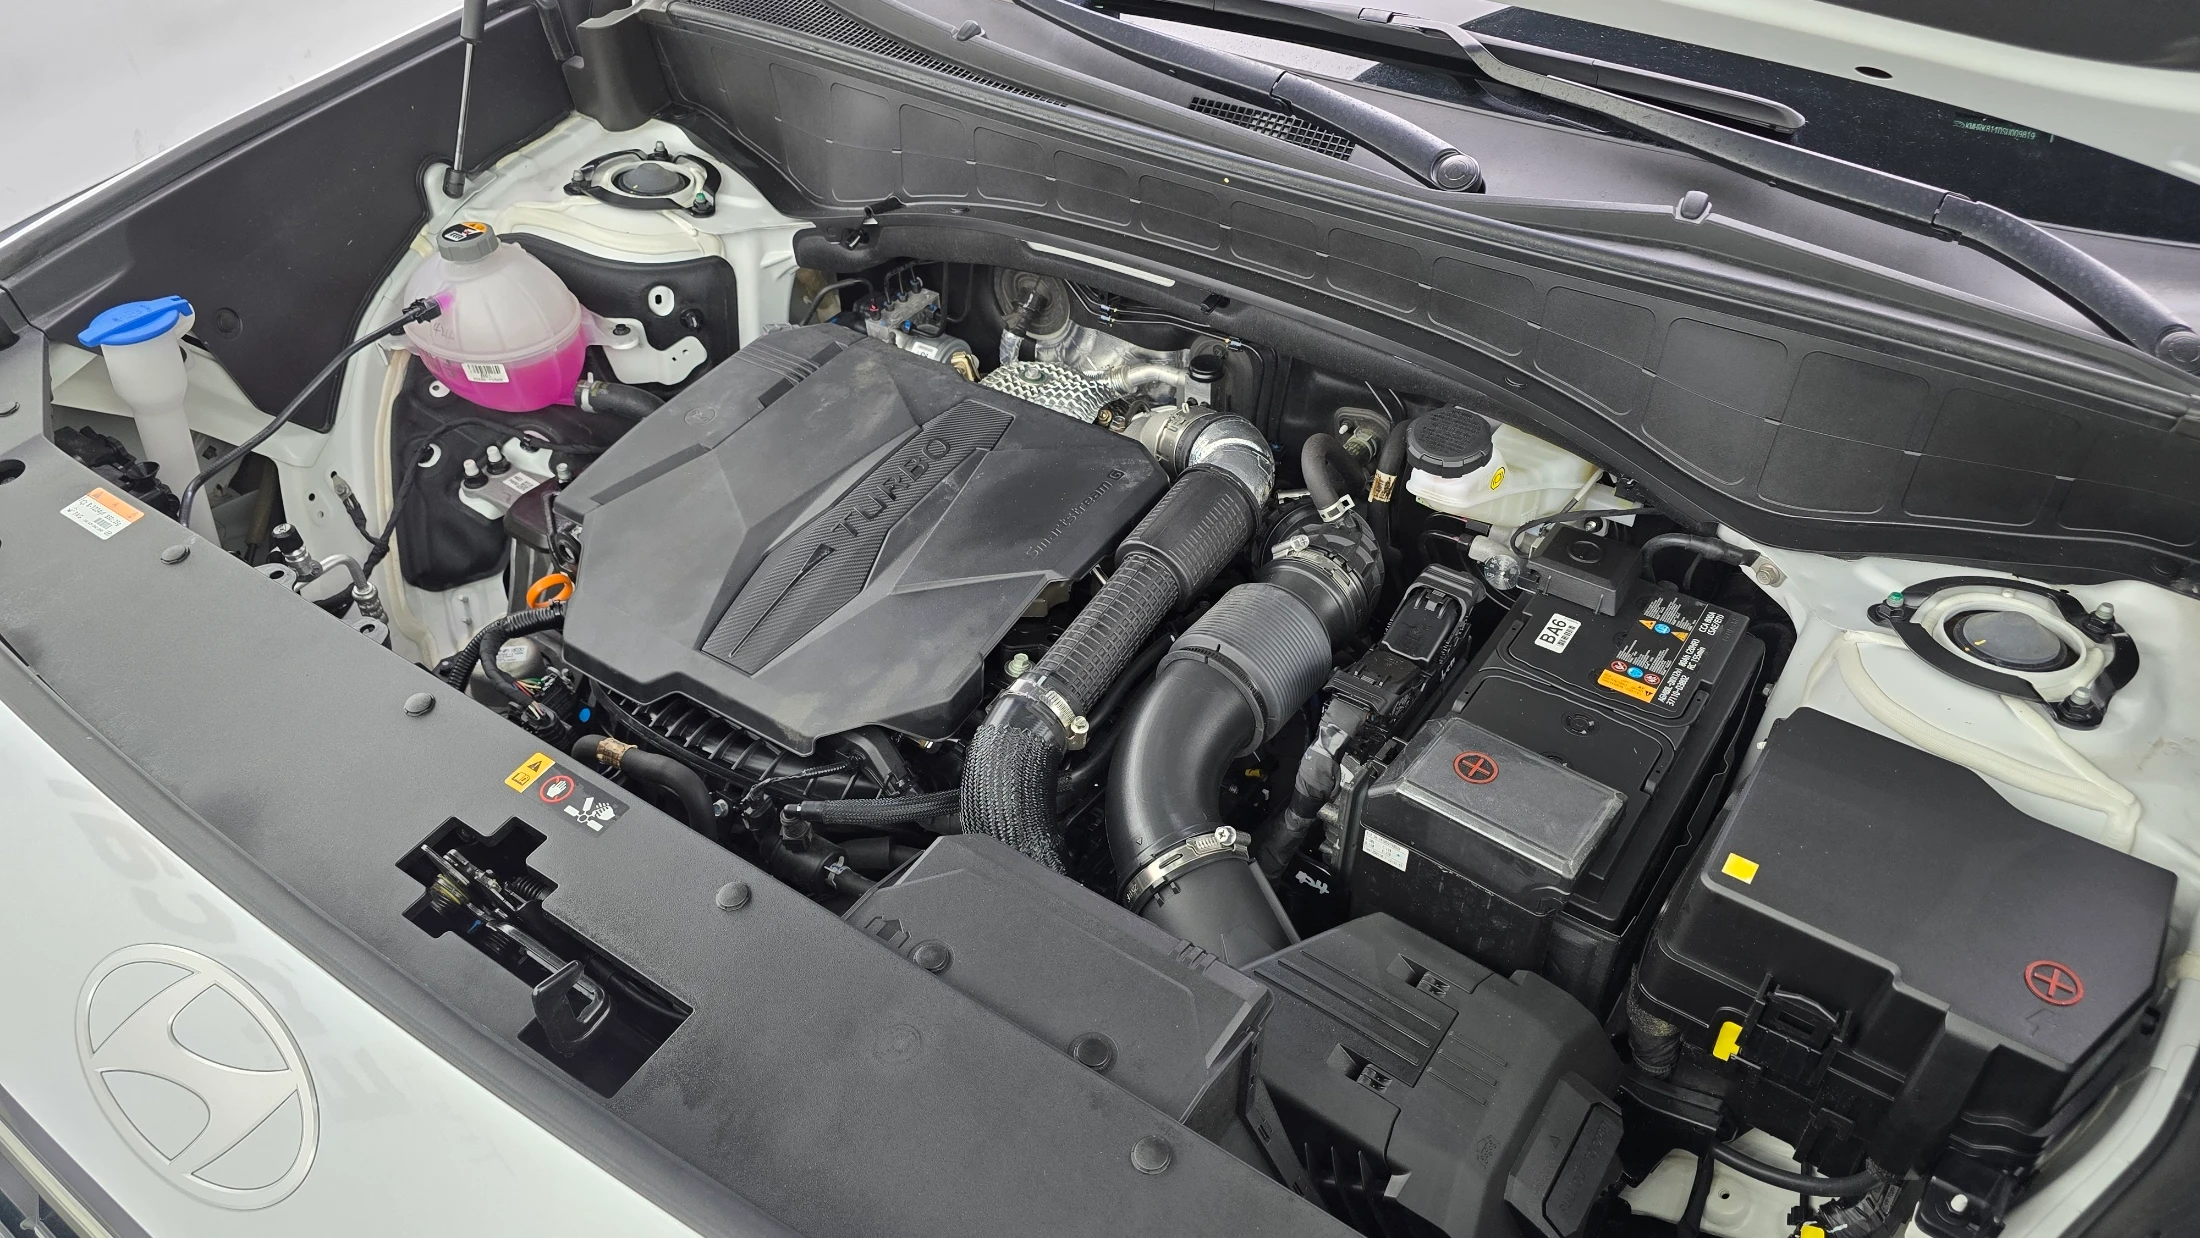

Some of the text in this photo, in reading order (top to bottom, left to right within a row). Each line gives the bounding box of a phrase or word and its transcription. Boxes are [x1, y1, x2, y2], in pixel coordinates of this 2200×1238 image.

[830, 437, 951, 537] TURBO
[1023, 469, 1125, 560] Smartstream G
[1539, 618, 1567, 645] BA6
